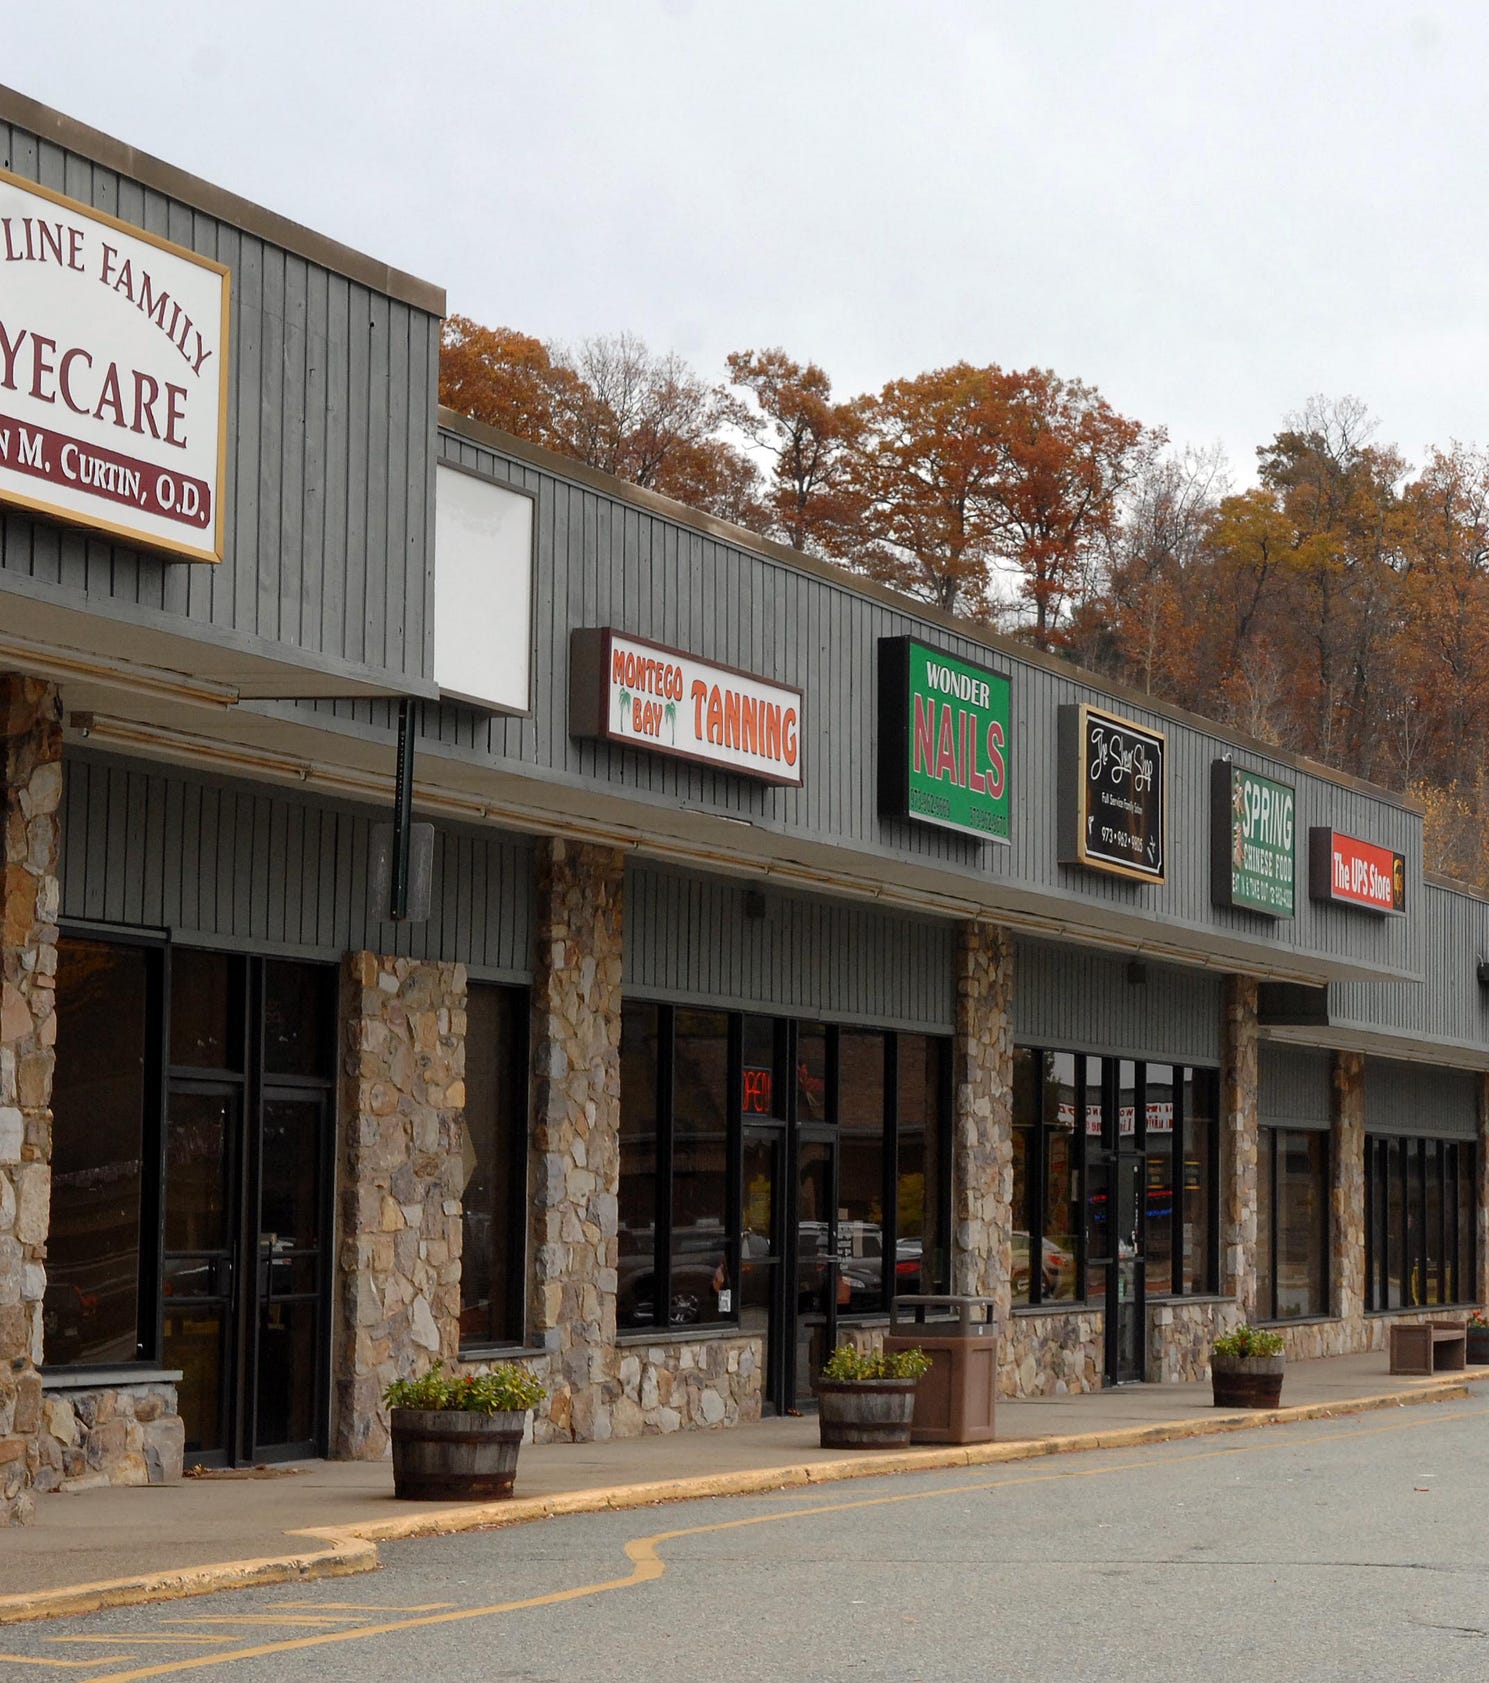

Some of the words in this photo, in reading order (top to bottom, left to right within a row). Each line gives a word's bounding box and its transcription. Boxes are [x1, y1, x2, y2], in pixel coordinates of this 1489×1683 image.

[100, 242, 212, 377] FAMILY
[17, 428, 51, 473] M.
[155, 474, 206, 522] O.D.
[612, 649, 683, 701] MONTEGO
[691, 679, 797, 767] TANNING
[632, 697, 663, 737] BAY
[926, 661, 990, 709] WONDER
[913, 692, 1005, 800] NAILS
[1090, 727, 1108, 780] The
[1133, 744, 1153, 792] Shop
[1243, 780, 1292, 851] SPRING
[1243, 843, 1273, 877] CHINESE
[1275, 853, 1292, 882] FOOD
[1334, 851, 1350, 891] The
[1351, 856, 1368, 896] UPS
[1369, 863, 1391, 902] Store
